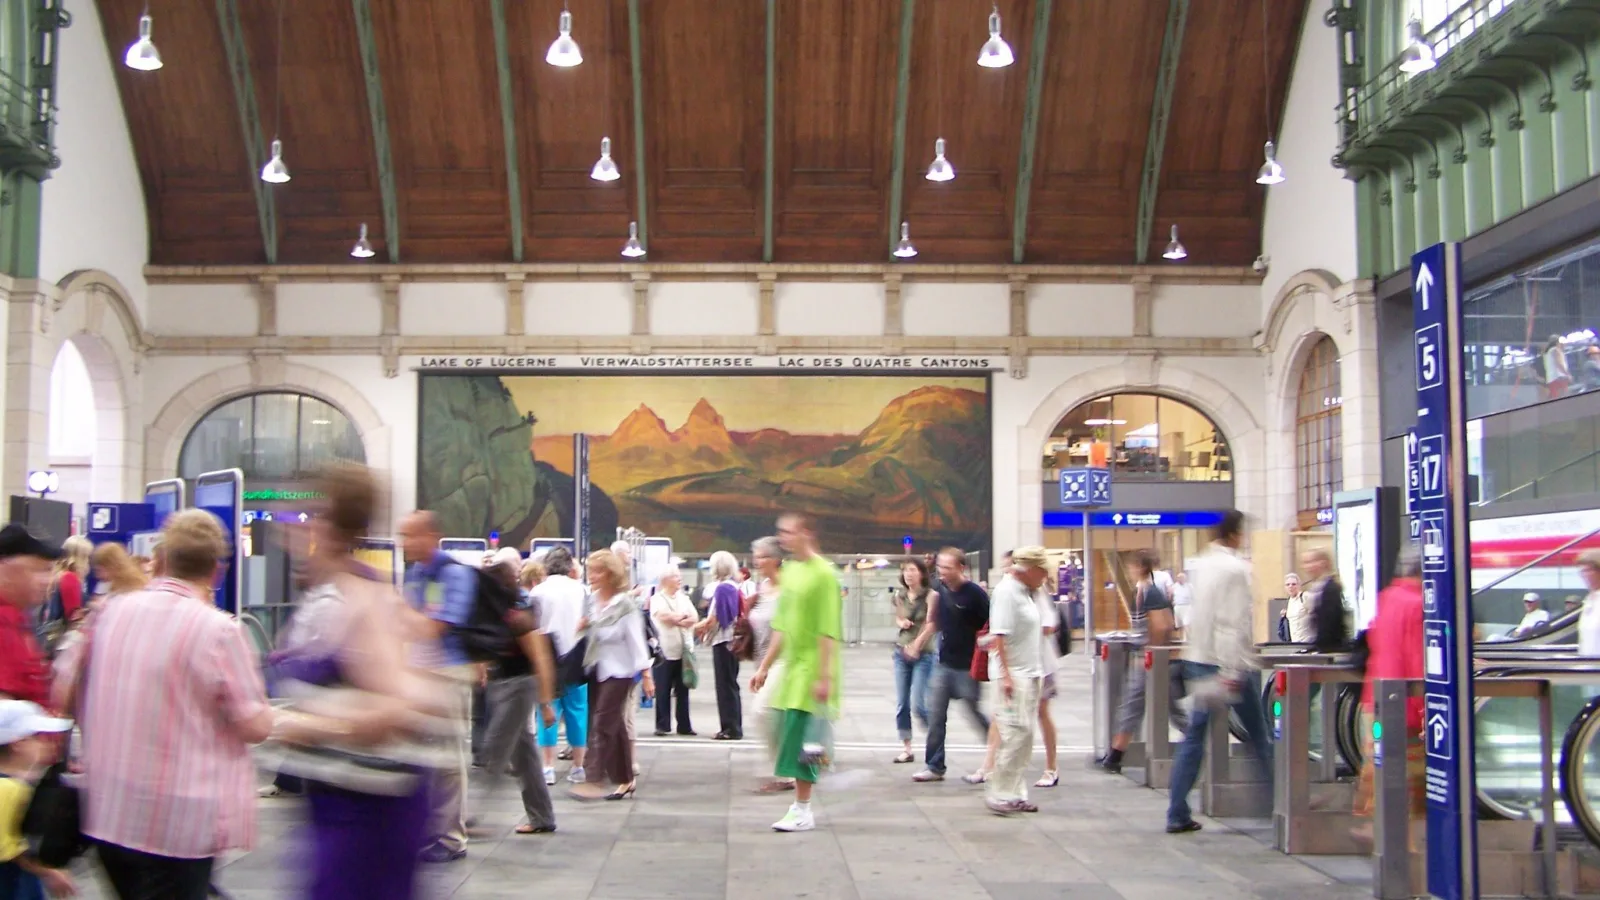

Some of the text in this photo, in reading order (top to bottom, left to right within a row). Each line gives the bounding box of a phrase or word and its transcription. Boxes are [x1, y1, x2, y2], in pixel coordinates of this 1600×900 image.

[421, 357, 556, 367] LAKE OF LUCERNE
[580, 356, 753, 367] VIERWALDSTÄTTERSEE
[778, 357, 989, 367] LAC DES QUATRE CANTONS
[1423, 344, 1436, 381] 5
[1410, 470, 1419, 487] 5
[1421, 454, 1441, 491] 17
[242, 488, 328, 500] sundheitszentru
